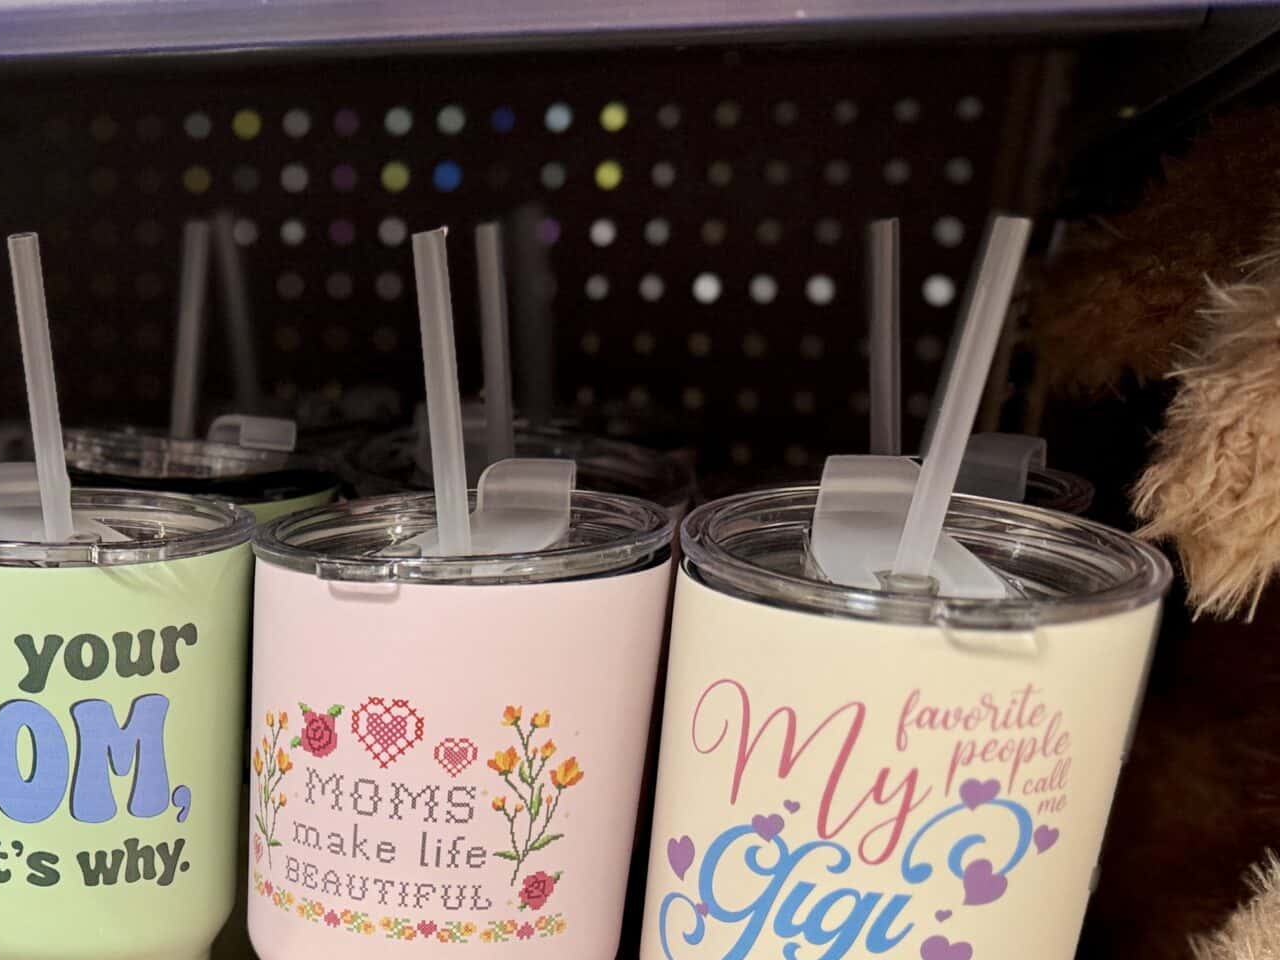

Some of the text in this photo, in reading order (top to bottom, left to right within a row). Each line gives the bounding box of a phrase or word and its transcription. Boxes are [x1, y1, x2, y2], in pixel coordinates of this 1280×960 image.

[14, 622, 198, 693] your
[896, 684, 1046, 752] favorite
[692, 678, 933, 866] My
[945, 711, 1071, 798] people
[1022, 757, 1073, 796] call
[305, 766, 476, 824] MOMS
[1036, 795, 1067, 816] me
[76, 837, 190, 886] why.
[292, 820, 488, 868] make life
[285, 855, 492, 911] BEAUTIFUL
